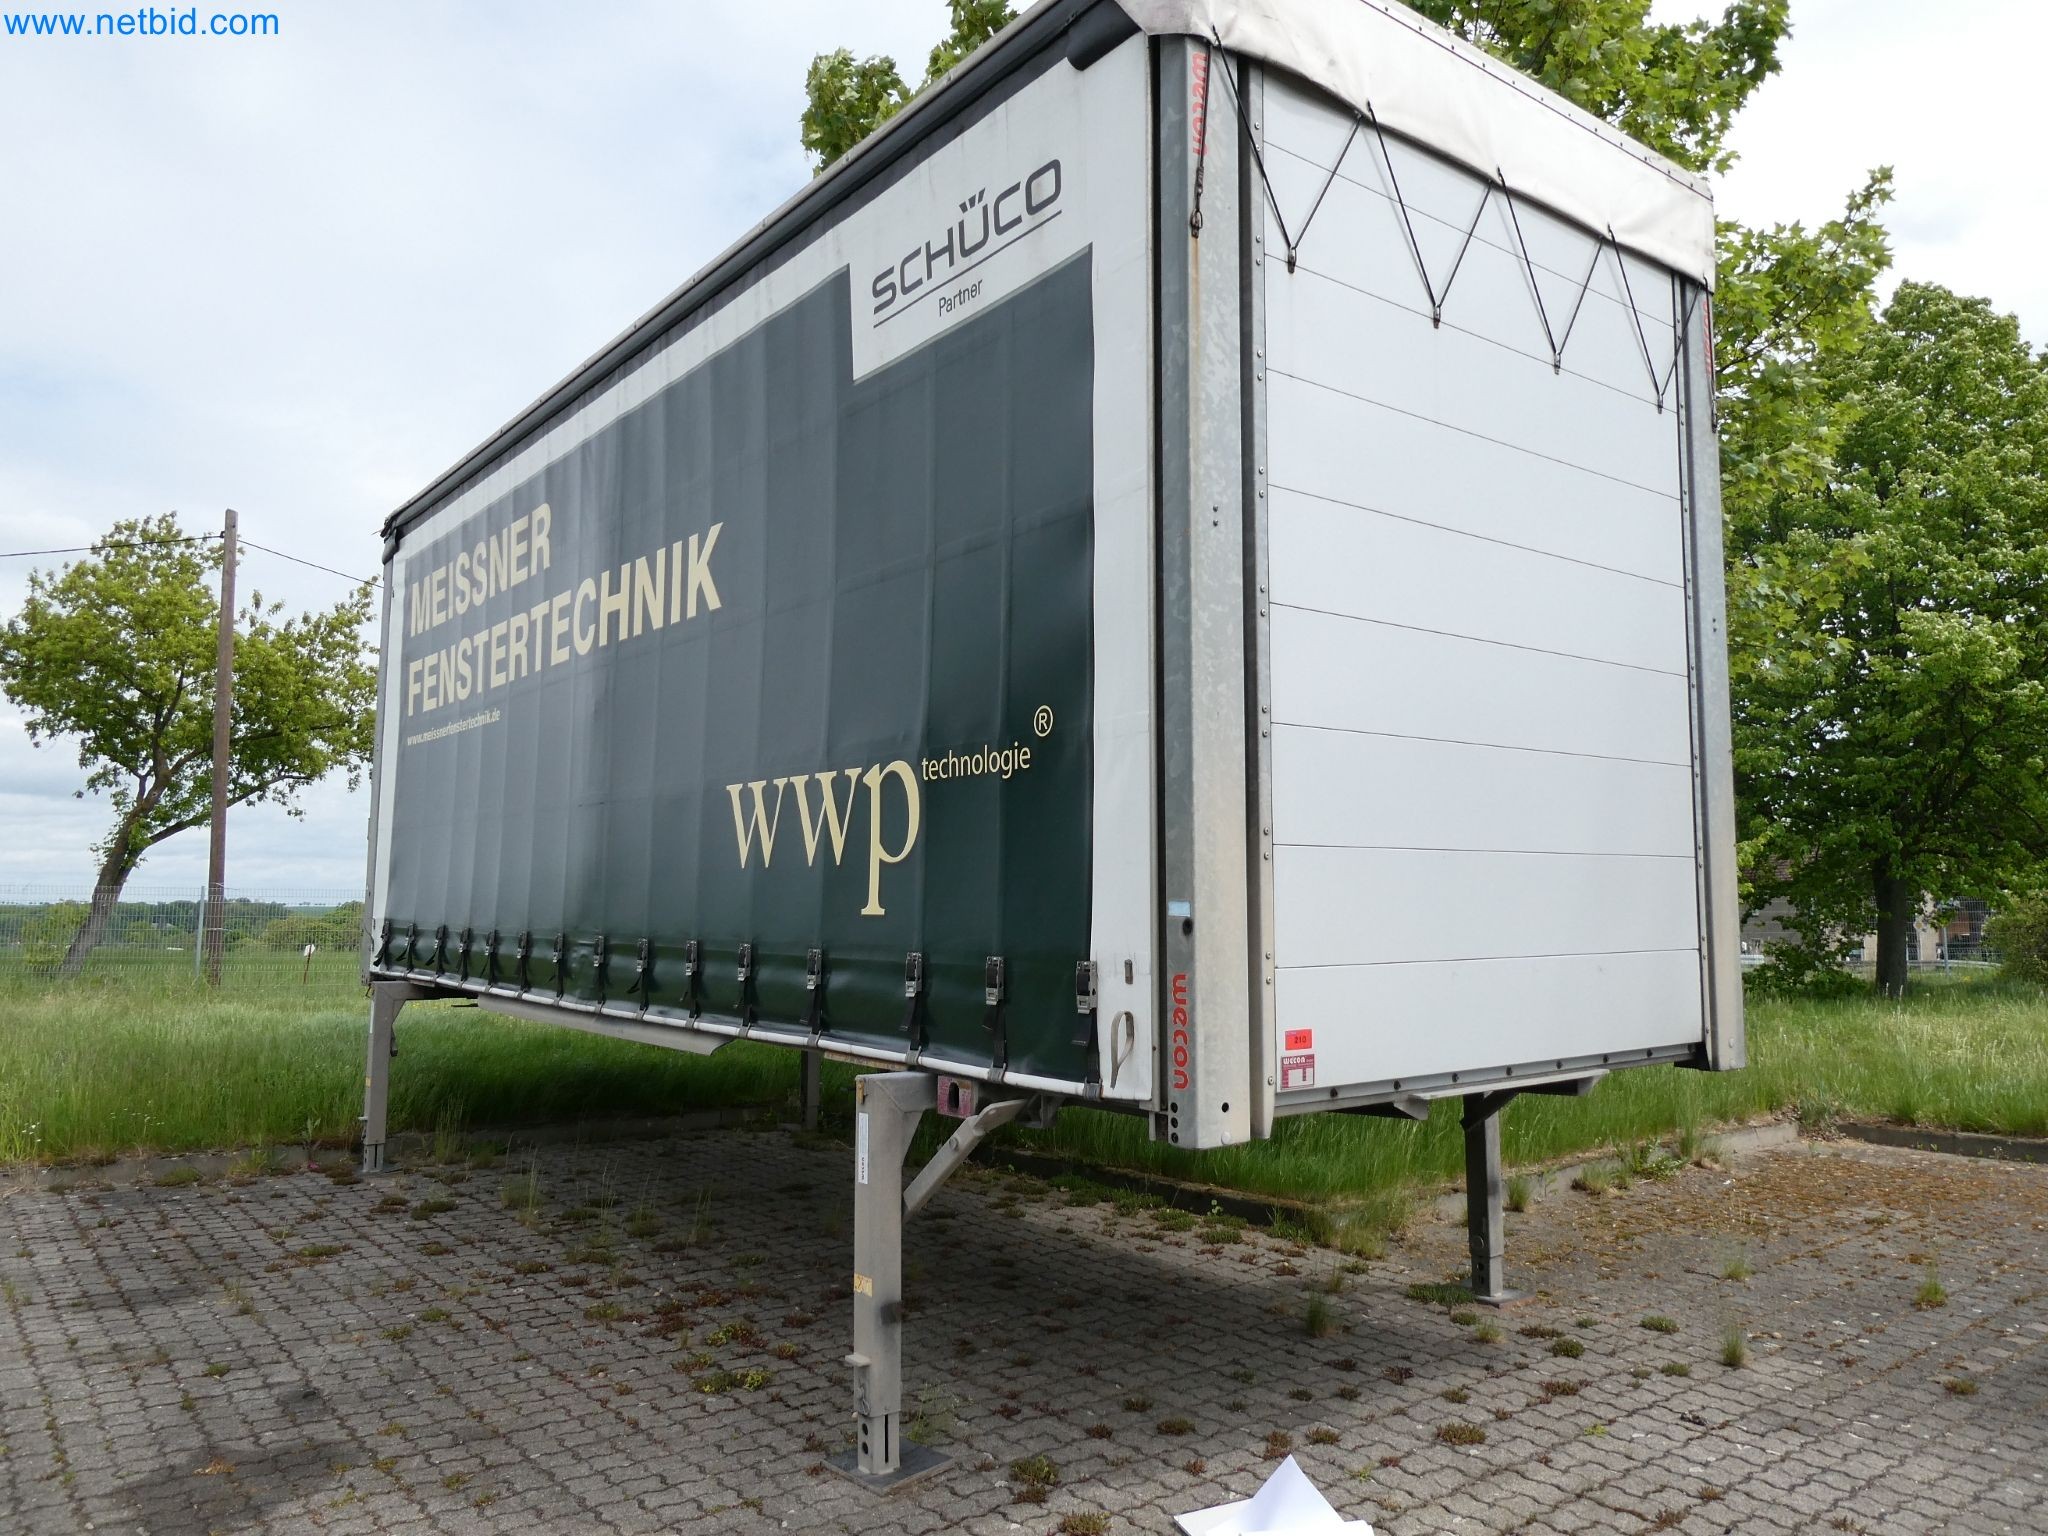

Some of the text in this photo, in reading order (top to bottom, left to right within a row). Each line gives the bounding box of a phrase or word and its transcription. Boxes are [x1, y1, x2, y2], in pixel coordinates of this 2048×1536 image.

[872, 159, 1062, 316] SCHÜCO
[938, 280, 983, 317] Partner
[408, 522, 724, 716] FENSTERTECHNIK
[410, 502, 551, 638] MEISSNER
[726, 760, 920, 915] wwp
[921, 741, 1031, 781] technologie
[1171, 973, 1189, 1090] wecon
